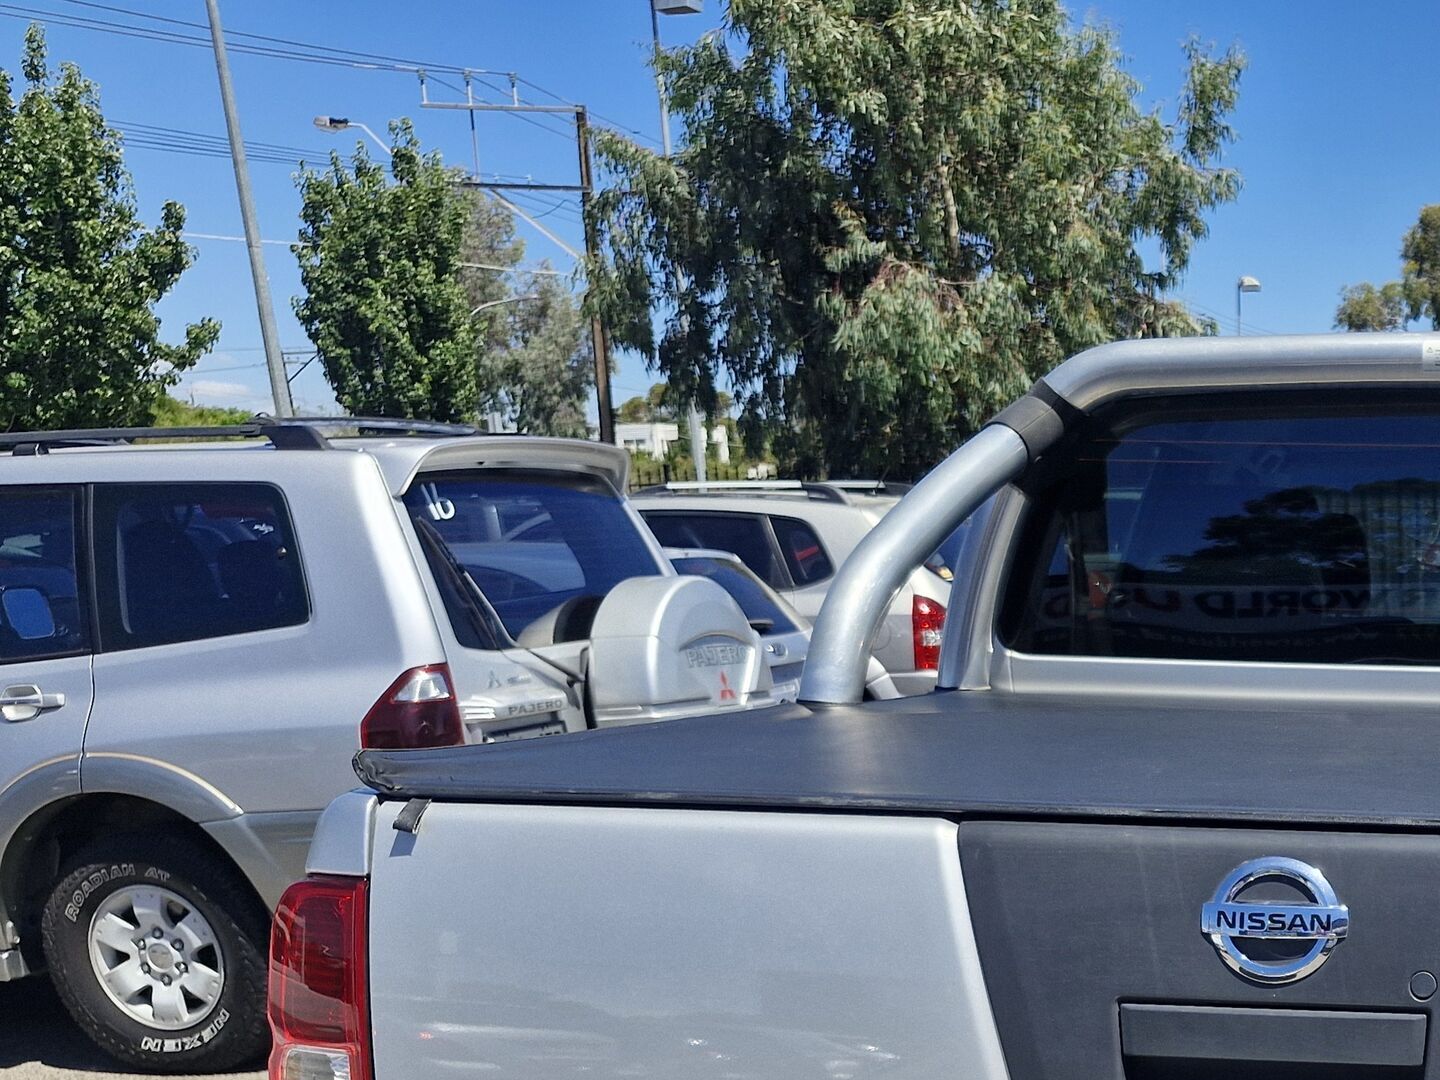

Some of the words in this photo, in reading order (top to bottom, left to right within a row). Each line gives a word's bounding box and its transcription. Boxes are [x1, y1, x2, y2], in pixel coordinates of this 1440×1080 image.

[508, 699, 563, 715] PAJERO
[64, 863, 136, 922] ROADIAN
[144, 866, 171, 882] AT
[1216, 909, 1332, 933] NISSAN
[141, 1008, 231, 1053] NEXEN
